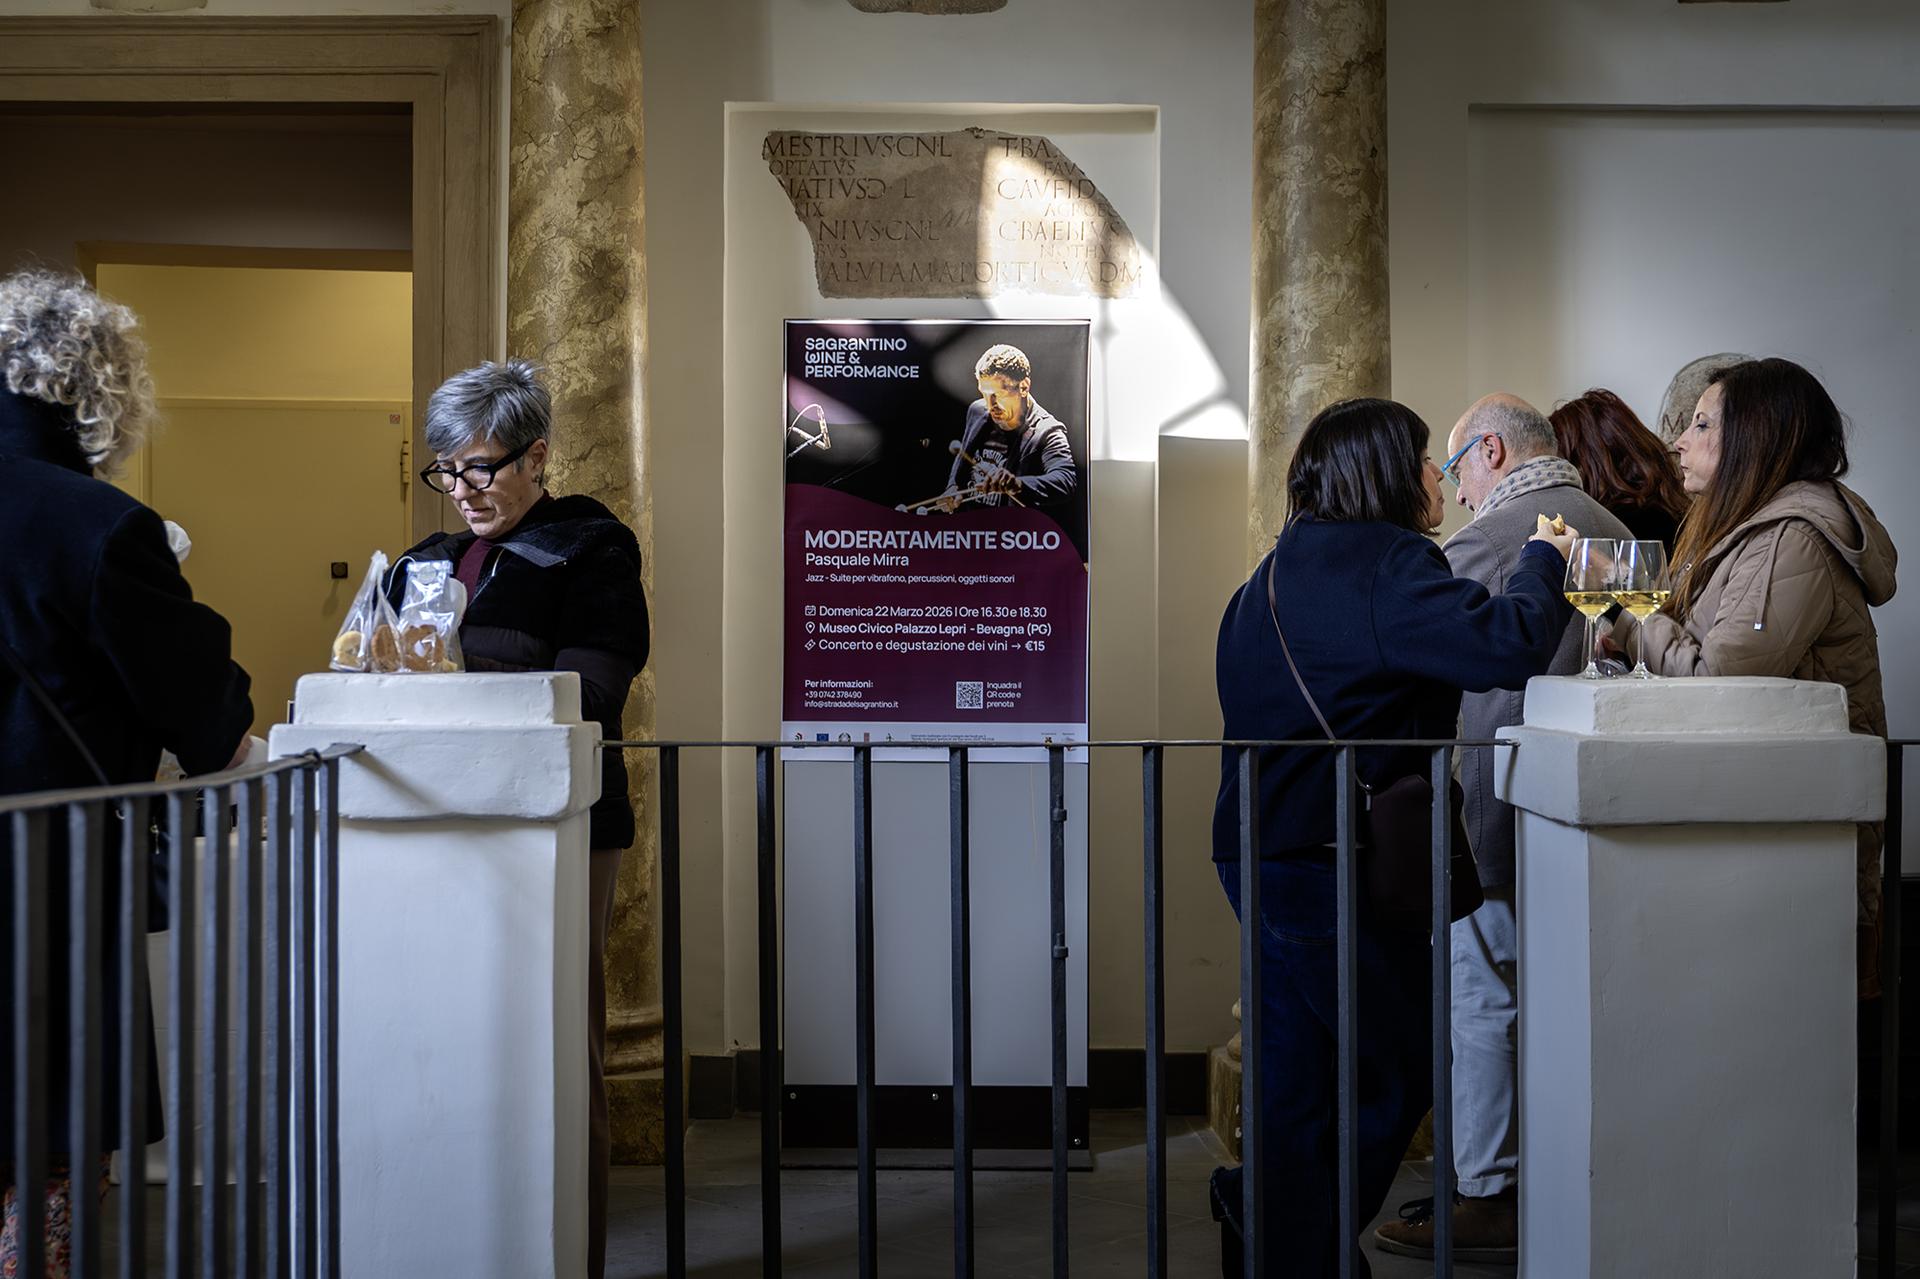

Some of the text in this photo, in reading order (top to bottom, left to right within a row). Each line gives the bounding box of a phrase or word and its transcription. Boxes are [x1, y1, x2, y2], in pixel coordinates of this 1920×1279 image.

[849, 351, 860, 364] &
[805, 530, 1060, 550] MODERATAMENTE SOLO
[806, 553, 909, 569] Pasquale Mirra
[805, 574, 824, 582] Jazz
[830, 573, 851, 582] Suite
[852, 575, 866, 584] per
[867, 574, 907, 583] vibrafono,
[908, 575, 957, 584] percussioni,
[958, 575, 990, 585] oggetti
[989, 575, 1014, 583] sonori
[820, 606, 873, 616] Domenica
[875, 606, 888, 616] 22
[890, 606, 923, 617] Marzo
[925, 606, 953, 617] 2026
[959, 607, 979, 617] Ore
[981, 607, 1009, 617] 16.30
[1010, 609, 1017, 617] e
[1019, 607, 1046, 617] 18.30
[820, 623, 857, 633] Museo
[858, 623, 893, 633] Civico
[895, 623, 937, 633] Palazzo
[939, 624, 966, 636] Lepri
[977, 624, 1024, 637] Bevagna
[1027, 623, 1051, 636] (PG)
[819, 639, 1045, 653] Concerto e degustazione dei vini €15
[820, 680, 873, 688] informazioni:
[987, 682, 1016, 690] Inquadra
[805, 700, 898, 709] info@stradadelsagrantino.it
[987, 701, 1014, 709] prenota
